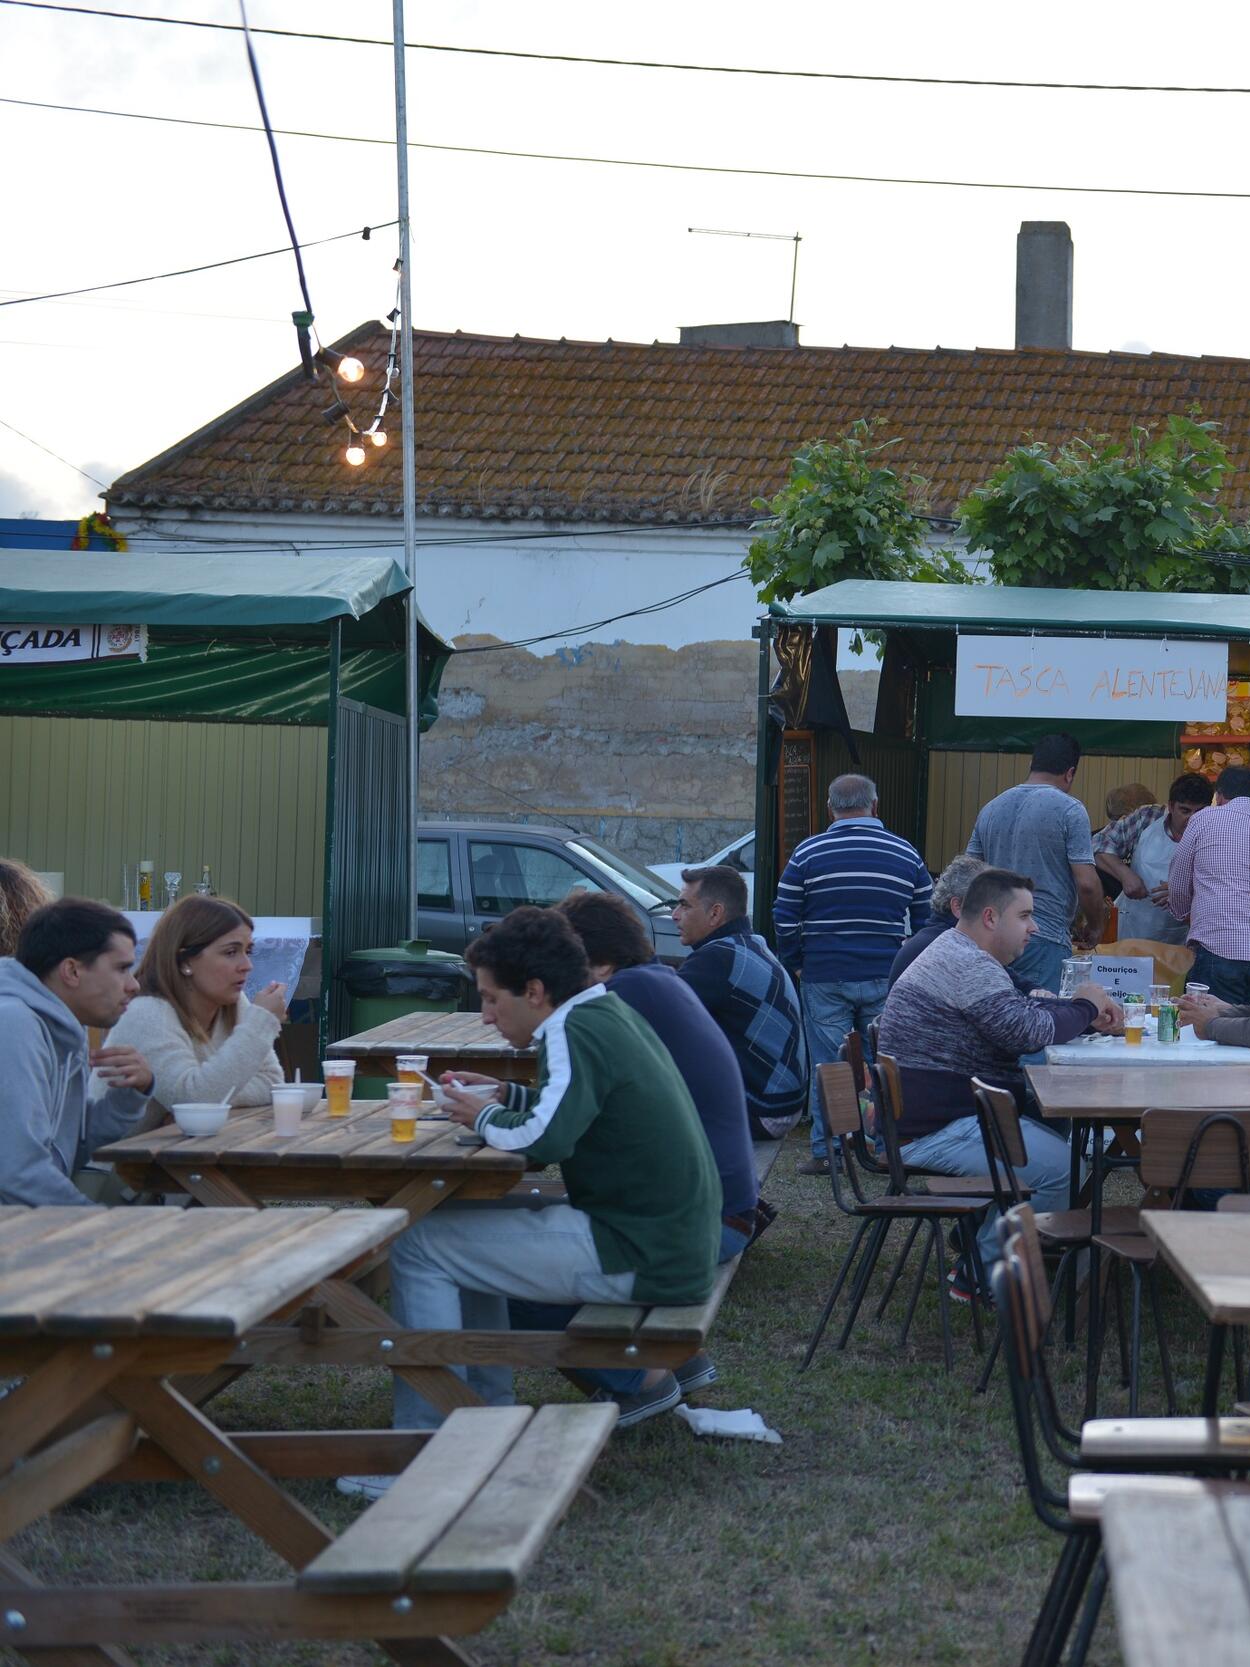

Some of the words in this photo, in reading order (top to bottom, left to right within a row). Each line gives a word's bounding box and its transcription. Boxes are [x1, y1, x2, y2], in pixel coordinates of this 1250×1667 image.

[0, 628, 82, 656] ÇADA
[974, 664, 1072, 697] TASCA
[1097, 965, 1138, 975] Chouriços
